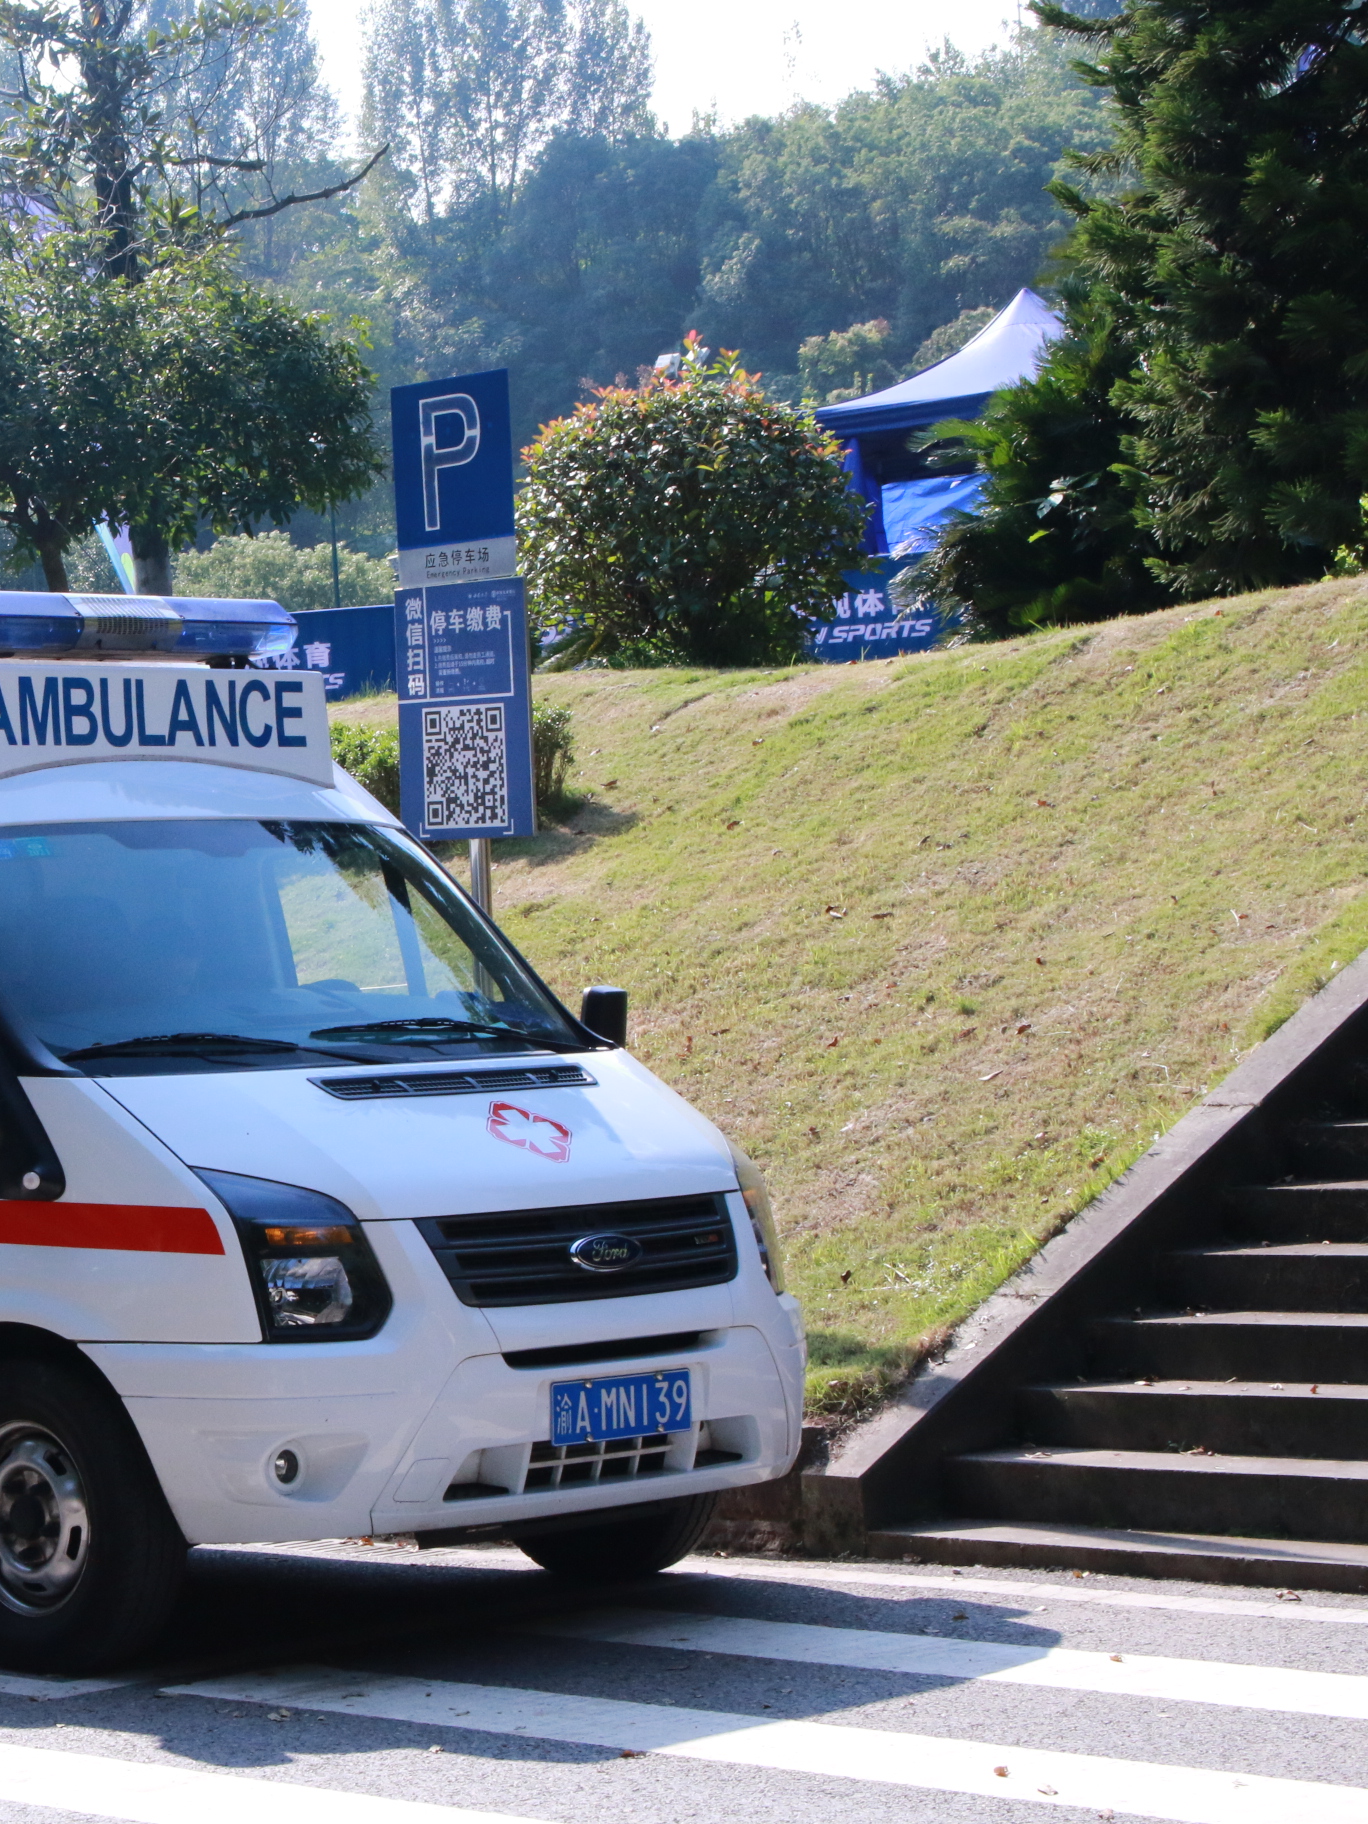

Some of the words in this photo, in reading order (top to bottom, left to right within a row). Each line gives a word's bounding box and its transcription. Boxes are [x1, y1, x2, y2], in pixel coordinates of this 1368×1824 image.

[419, 392, 481, 532] P
[425, 547, 490, 569] 应急停车场
[426, 569, 460, 579] Emergency
[462, 566, 490, 575] Parking
[429, 604, 502, 636] 停车缴费
[828, 619, 933, 644] SPORTS
[405, 597, 425, 696] 微信扫码
[591, 1239, 631, 1262] Ford
